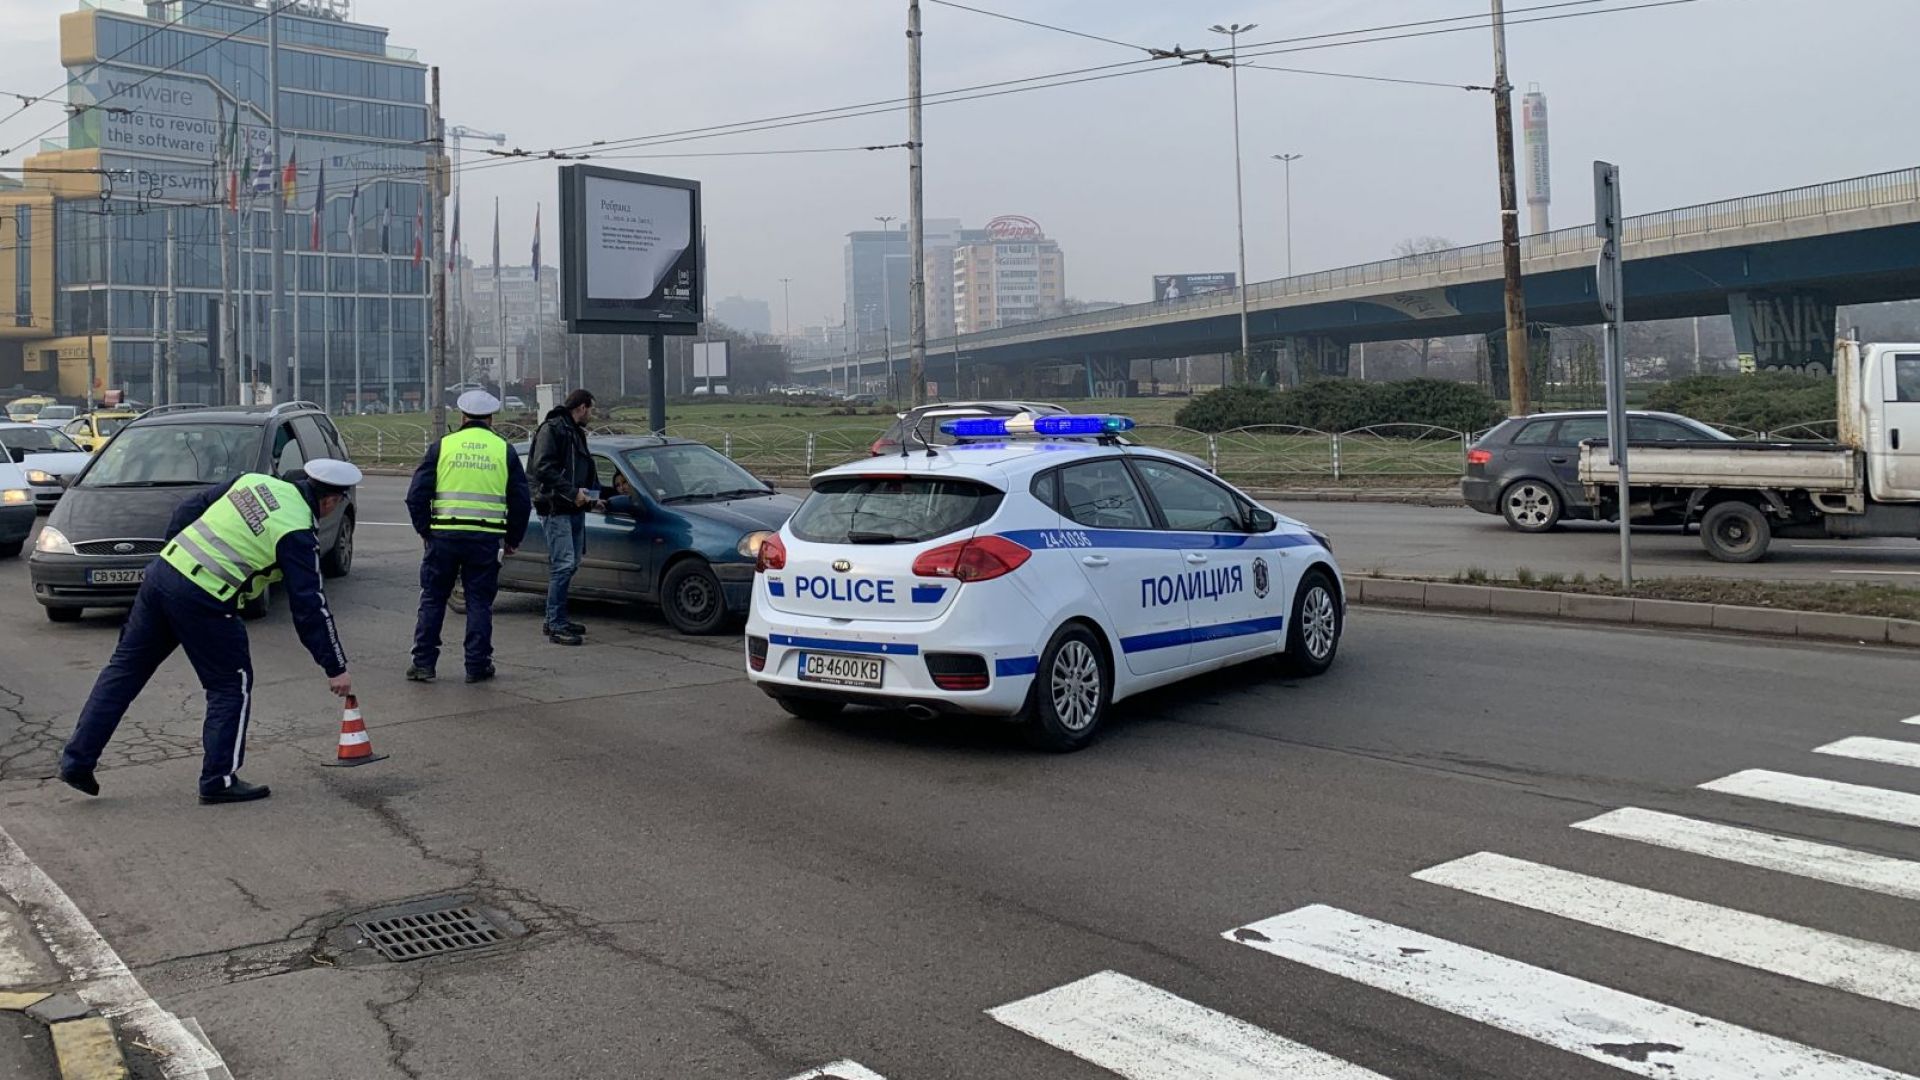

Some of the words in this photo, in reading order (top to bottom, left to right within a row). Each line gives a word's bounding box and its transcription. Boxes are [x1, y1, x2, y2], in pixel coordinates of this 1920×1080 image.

[107, 80, 192, 106] vmware
[108, 111, 144, 126] Dare
[150, 115, 165, 130] to
[108, 129, 133, 144] the
[137, 132, 204, 153] software
[1040, 531, 1092, 548] 24-1036
[795, 575, 896, 603] POLICE
[1141, 565, 1244, 608] ПОЛИЦИЯ
